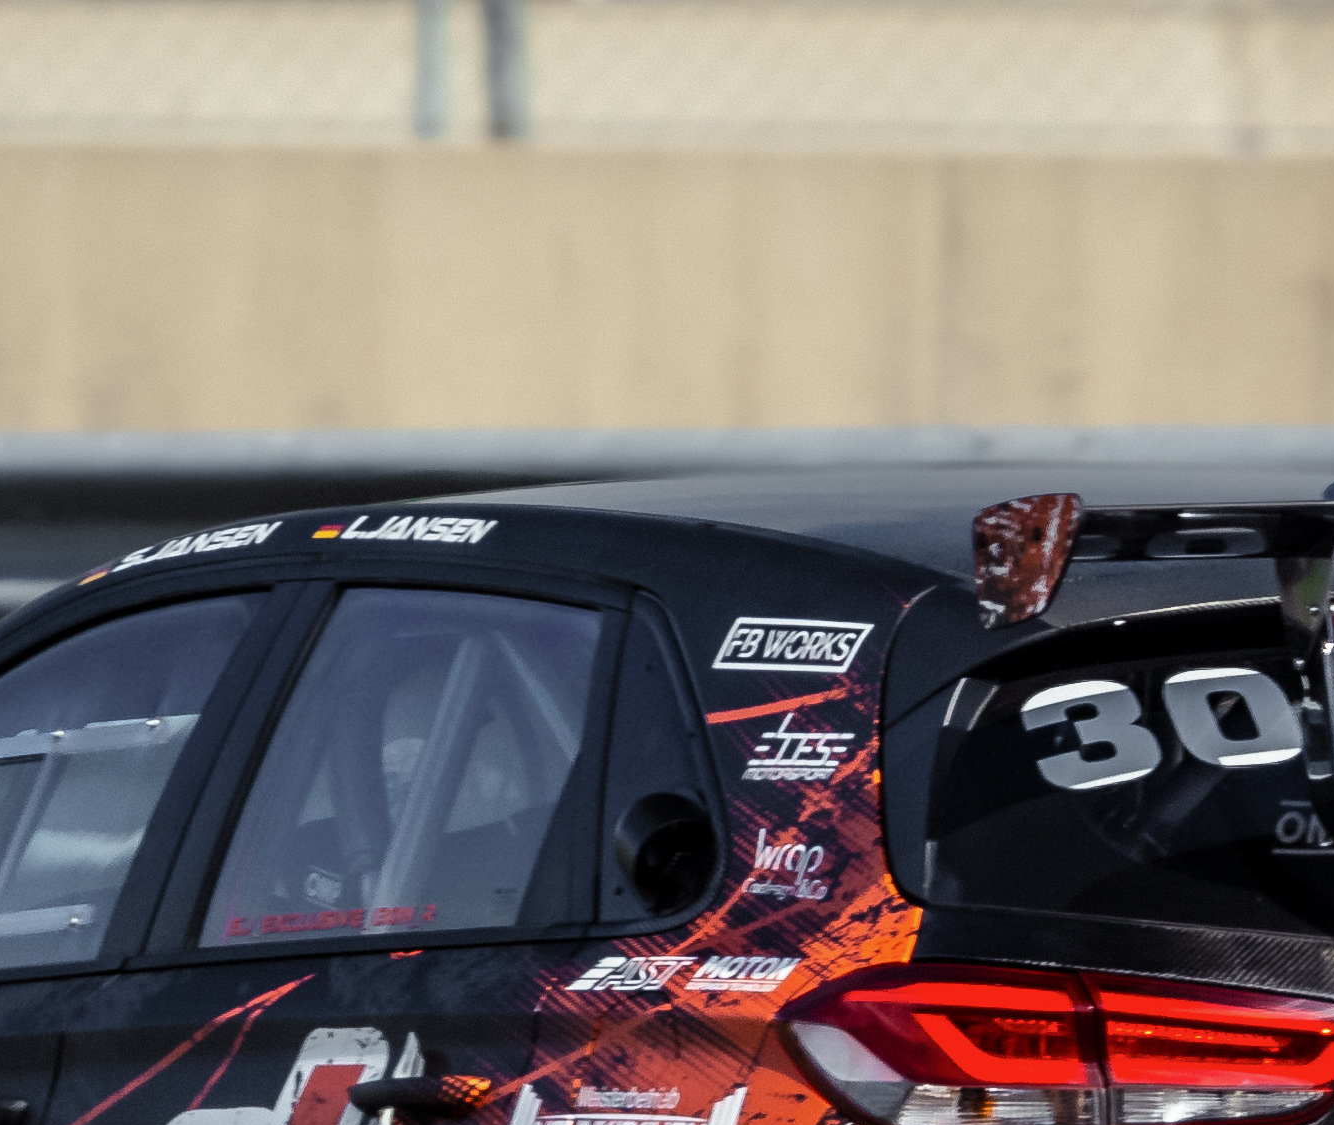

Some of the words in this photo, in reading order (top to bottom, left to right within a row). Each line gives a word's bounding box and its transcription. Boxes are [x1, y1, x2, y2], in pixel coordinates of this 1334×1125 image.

[724, 628, 765, 659] FB
[764, 631, 857, 663] WORKS
[1020, 667, 1303, 790] 30
[1274, 810, 1329, 845] OM
